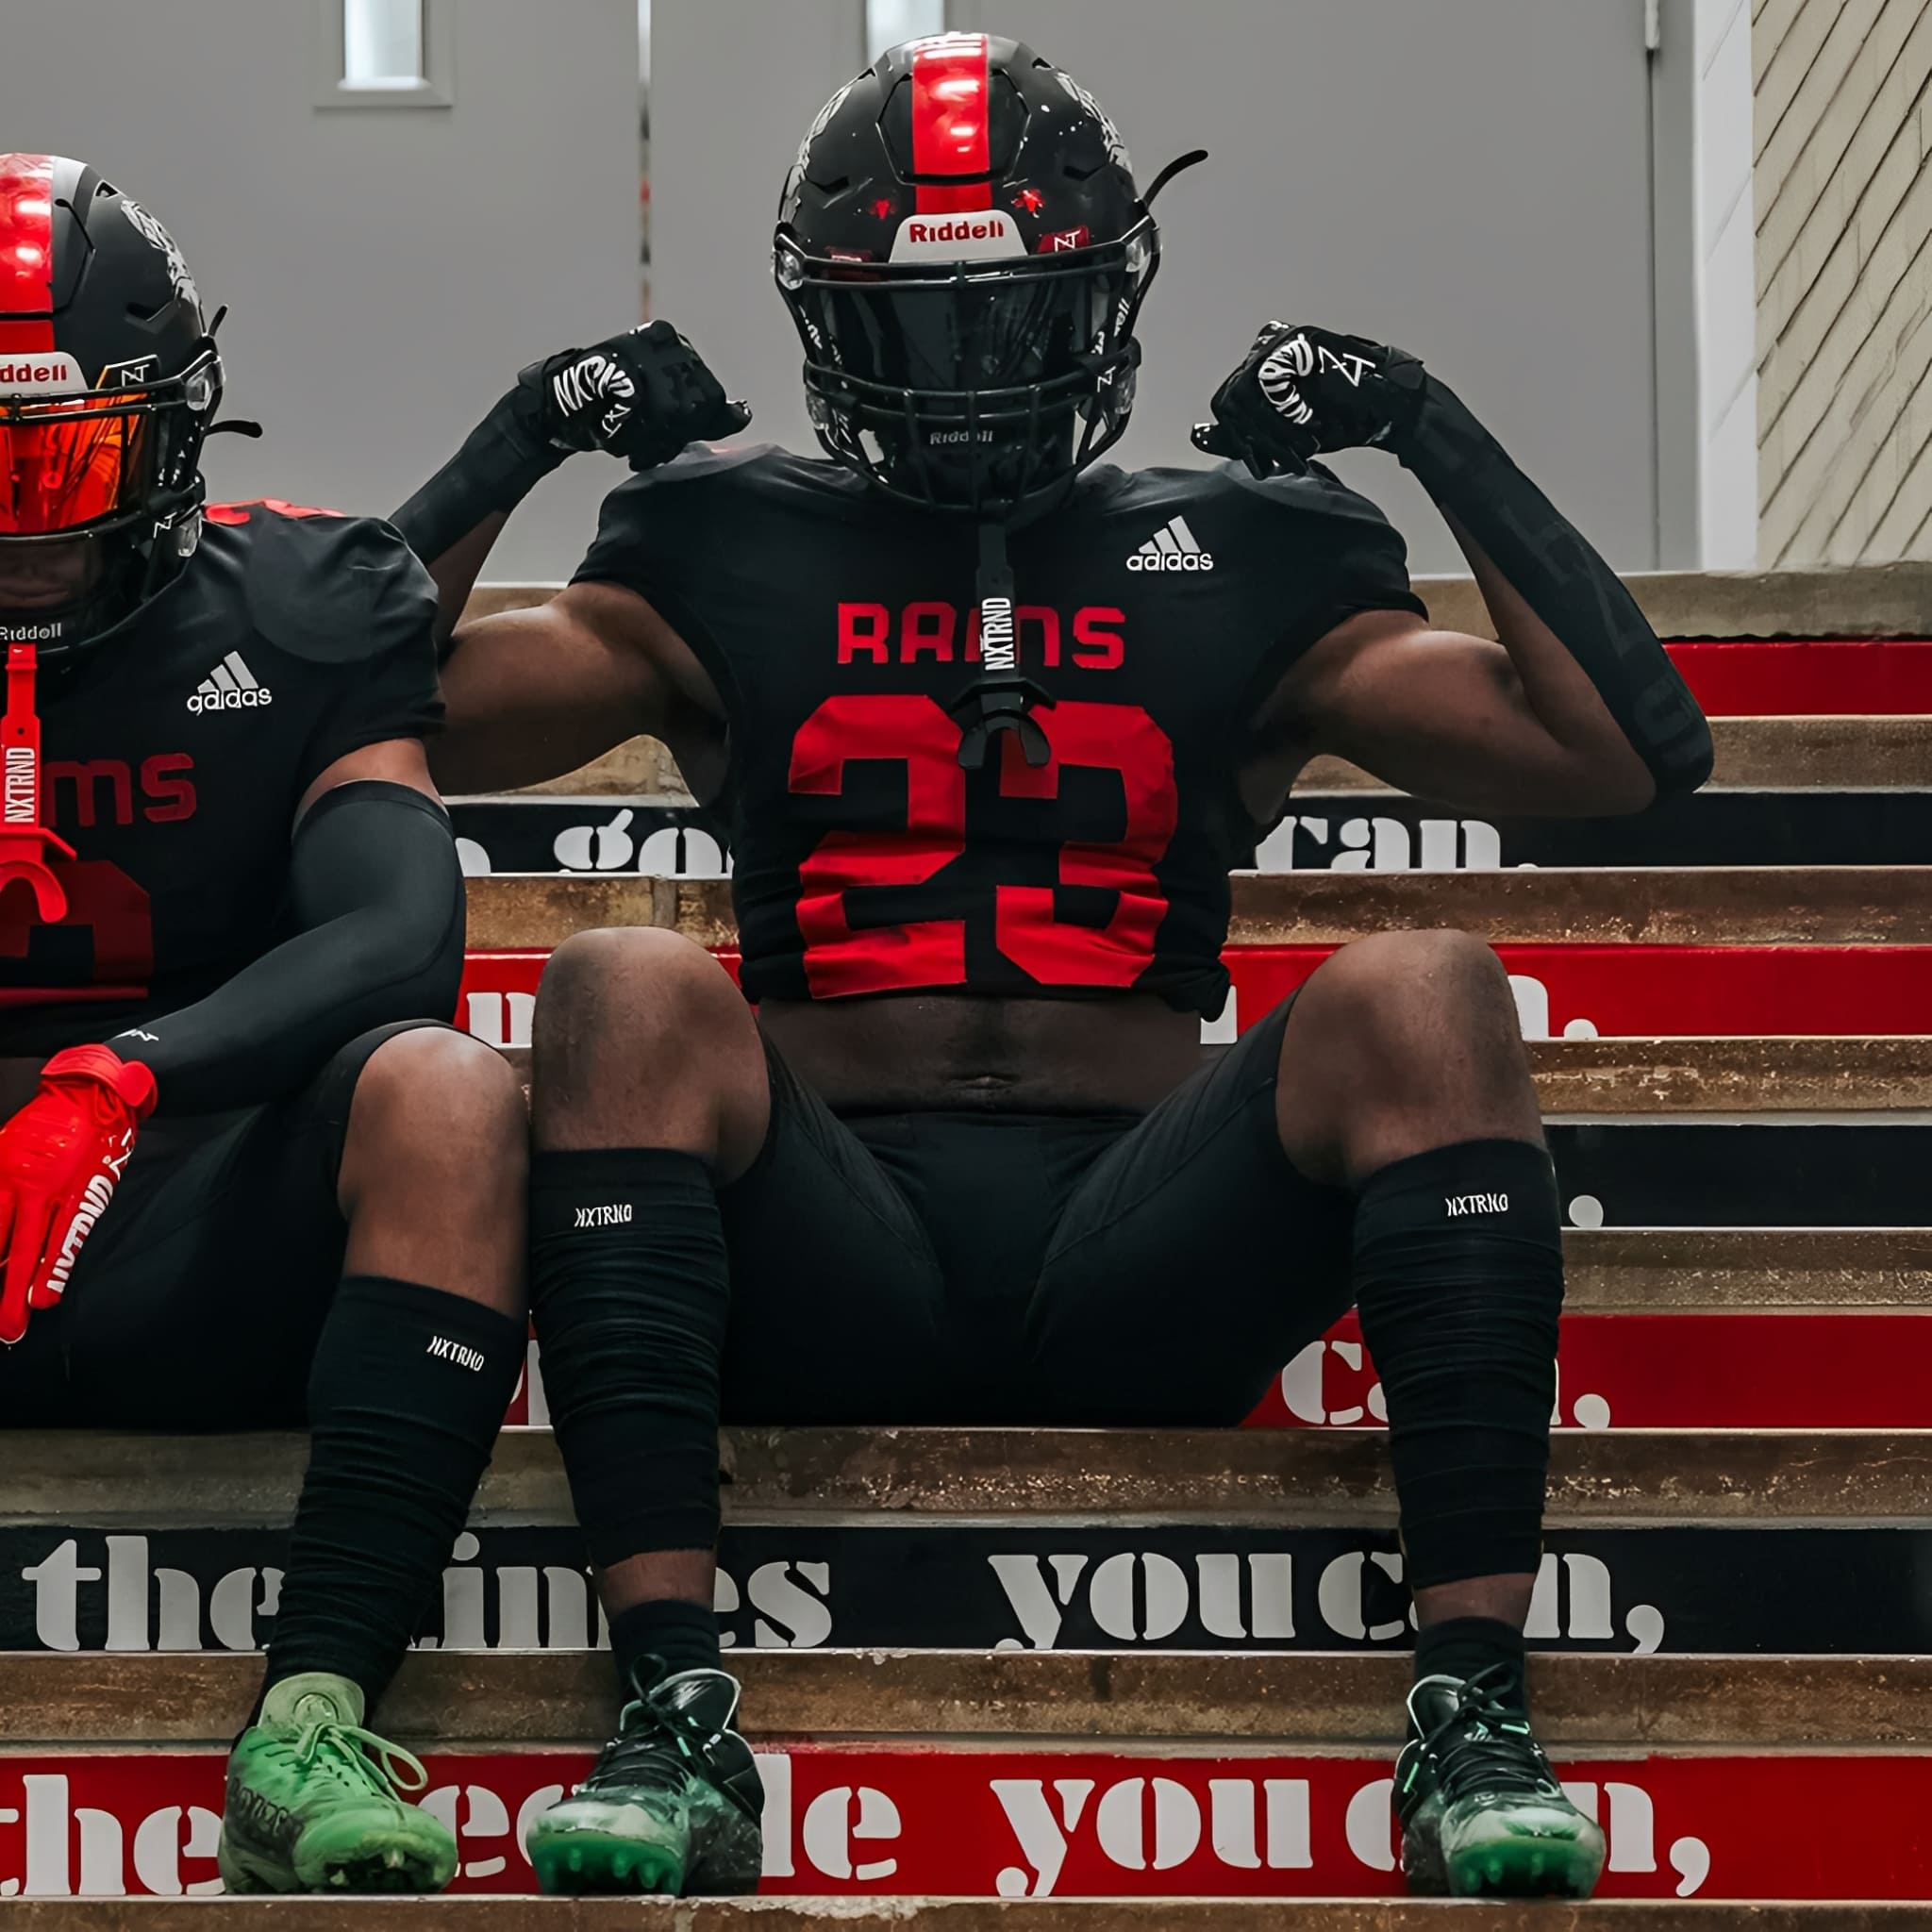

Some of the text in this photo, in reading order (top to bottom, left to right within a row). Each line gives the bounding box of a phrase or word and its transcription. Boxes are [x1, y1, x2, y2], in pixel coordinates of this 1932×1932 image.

[909, 220, 1004, 242] Riddell
[1126, 552, 1214, 571] adidas
[981, 597, 1015, 671] NXTRND
[187, 688, 273, 715] adidas
[4, 747, 36, 824] NXTRND
[788, 694, 1178, 1000] 23
[988, 1553, 1295, 1650] you
[1318, 1552, 1665, 1655] cn,
[0, 1774, 226, 1896] he
[990, 1777, 1314, 1897] you
